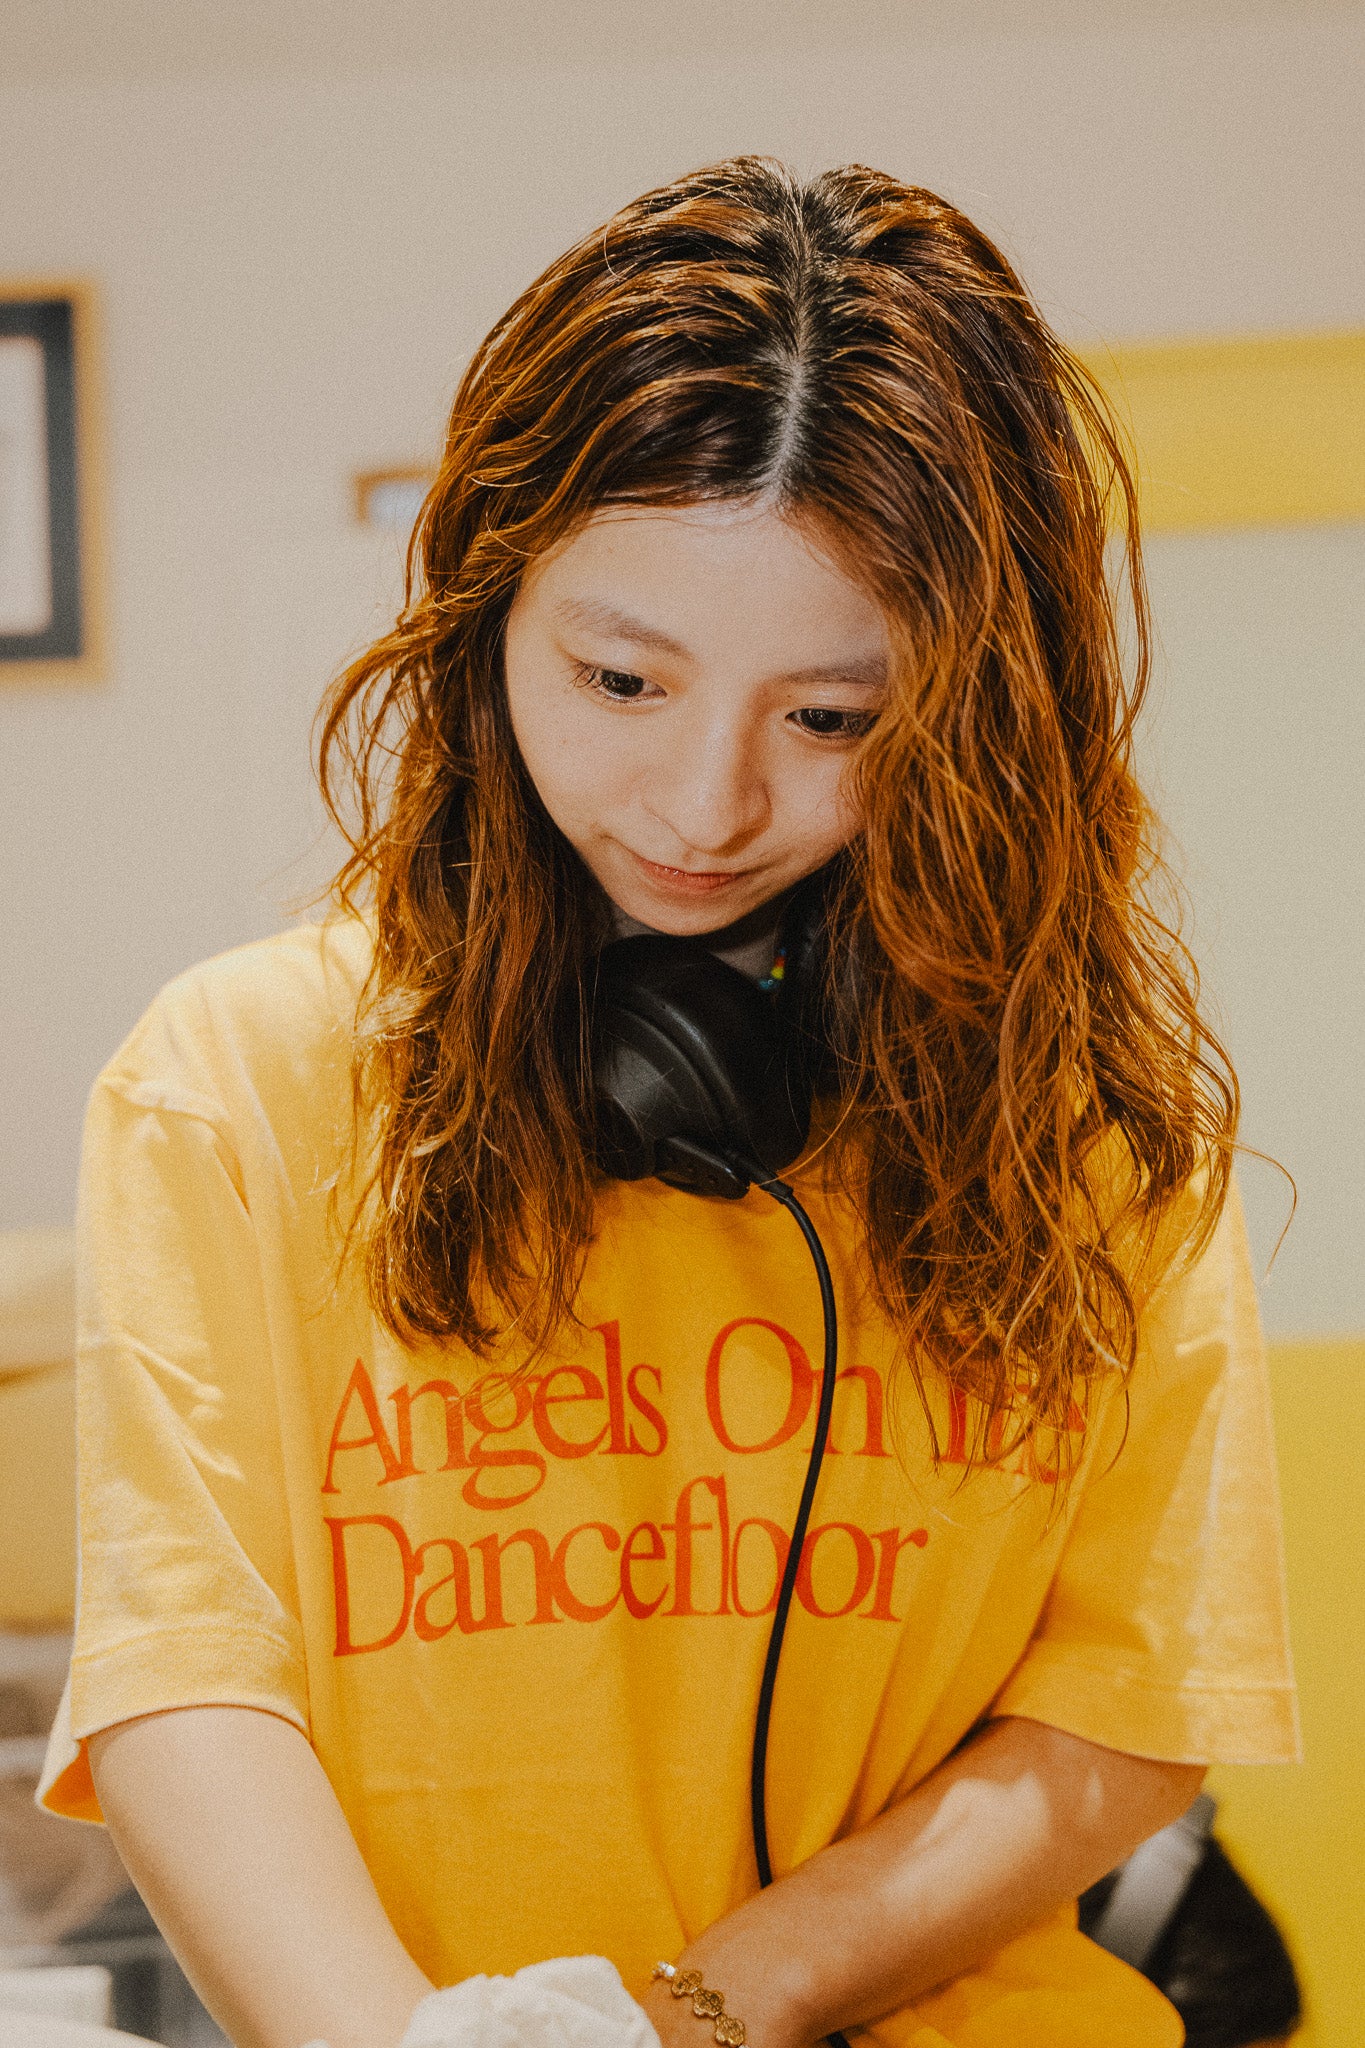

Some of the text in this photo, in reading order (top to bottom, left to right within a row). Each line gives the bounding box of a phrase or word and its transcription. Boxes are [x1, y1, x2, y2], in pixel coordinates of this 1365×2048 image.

[320, 1318, 669, 1511] Angels
[704, 1316, 890, 1458] On
[322, 1475, 930, 1658] Dancefloor
